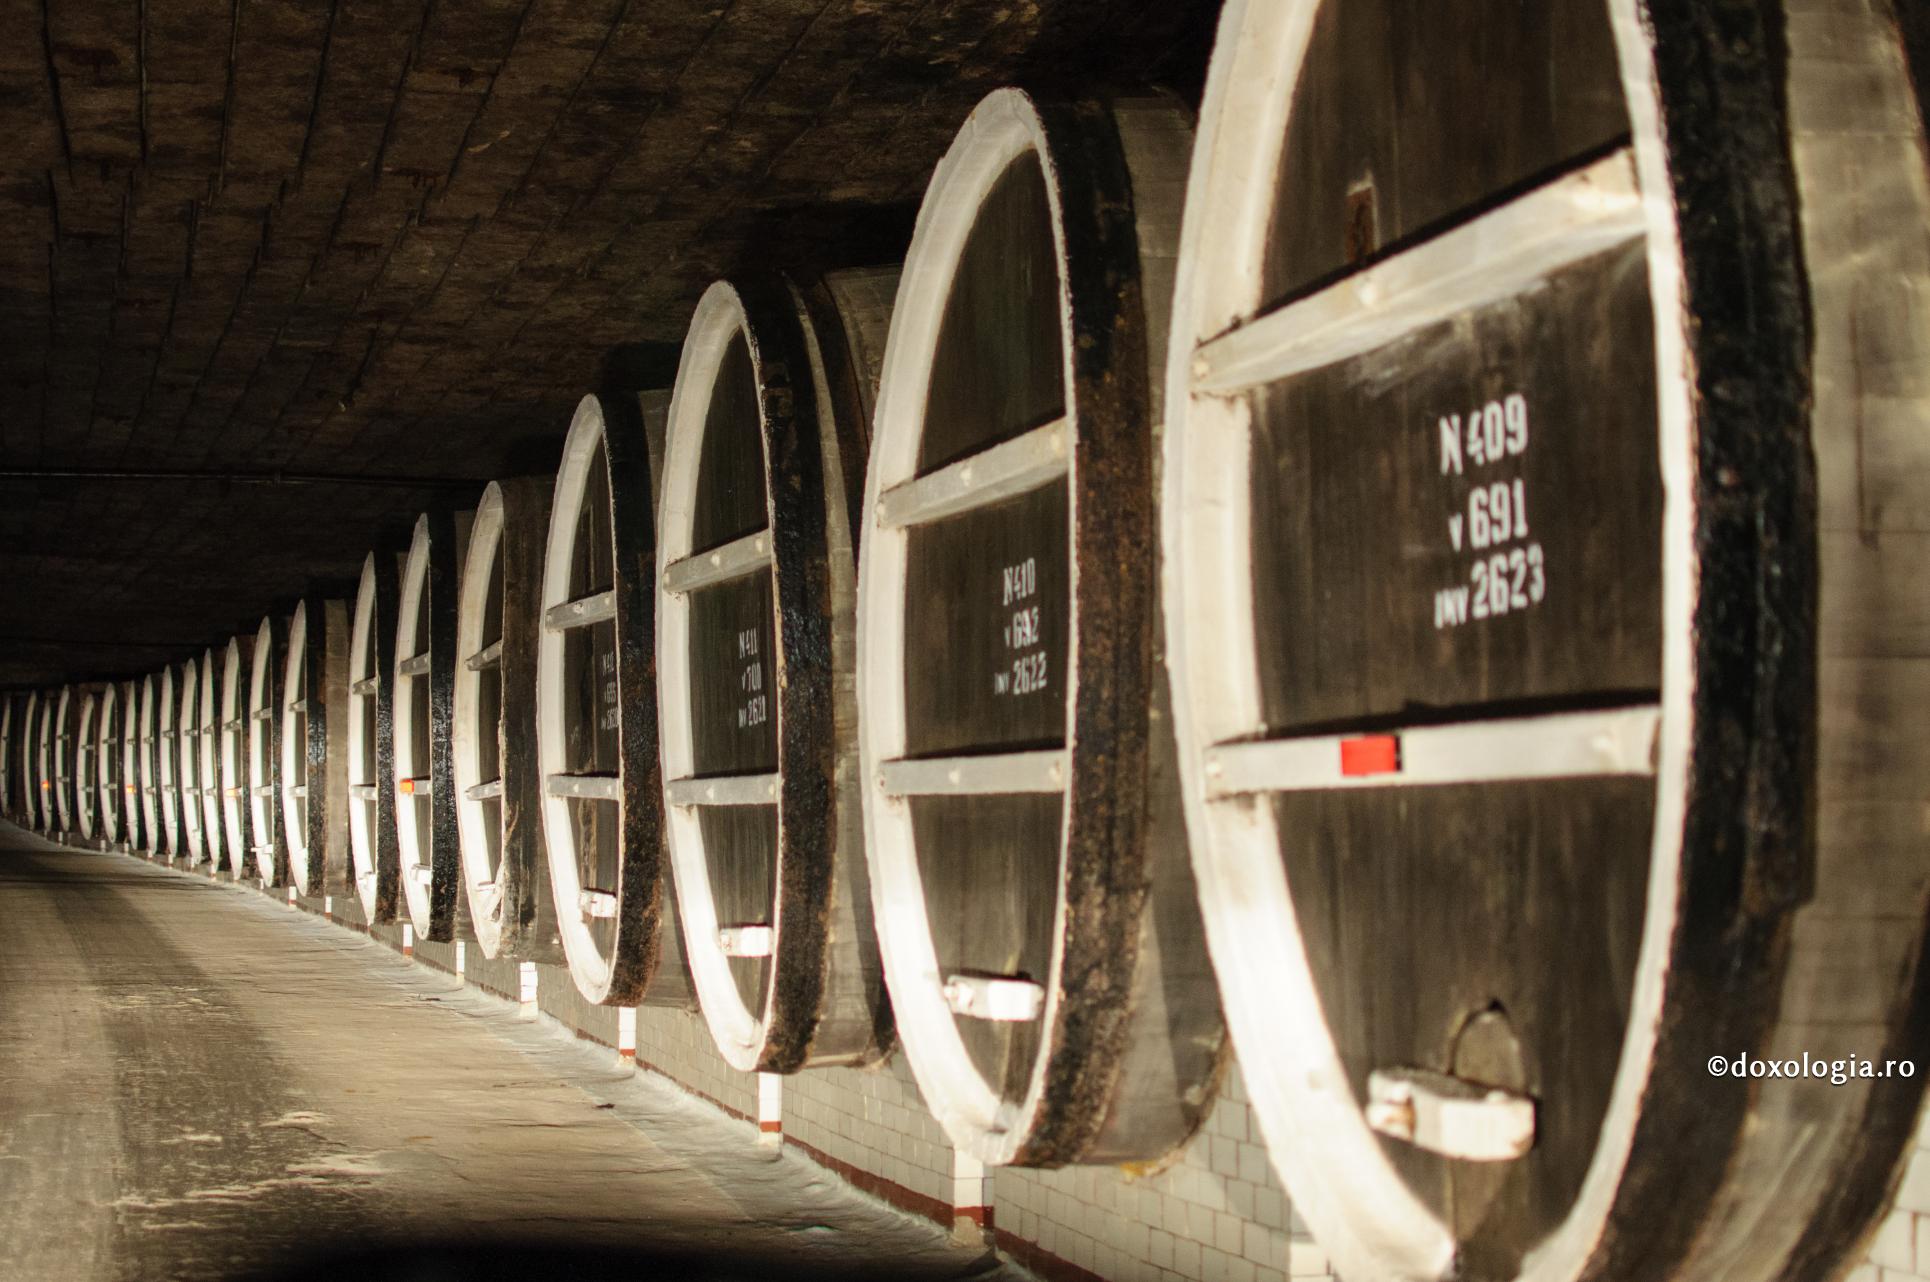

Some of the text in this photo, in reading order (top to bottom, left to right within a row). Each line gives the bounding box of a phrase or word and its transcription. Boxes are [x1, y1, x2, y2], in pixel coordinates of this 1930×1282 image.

[1468, 476, 1530, 550] 691
[1433, 540, 1547, 630] INV 2623
[1012, 605, 1039, 650] 692
[1012, 651, 1048, 695] 2622
[747, 695, 767, 727] 2621
